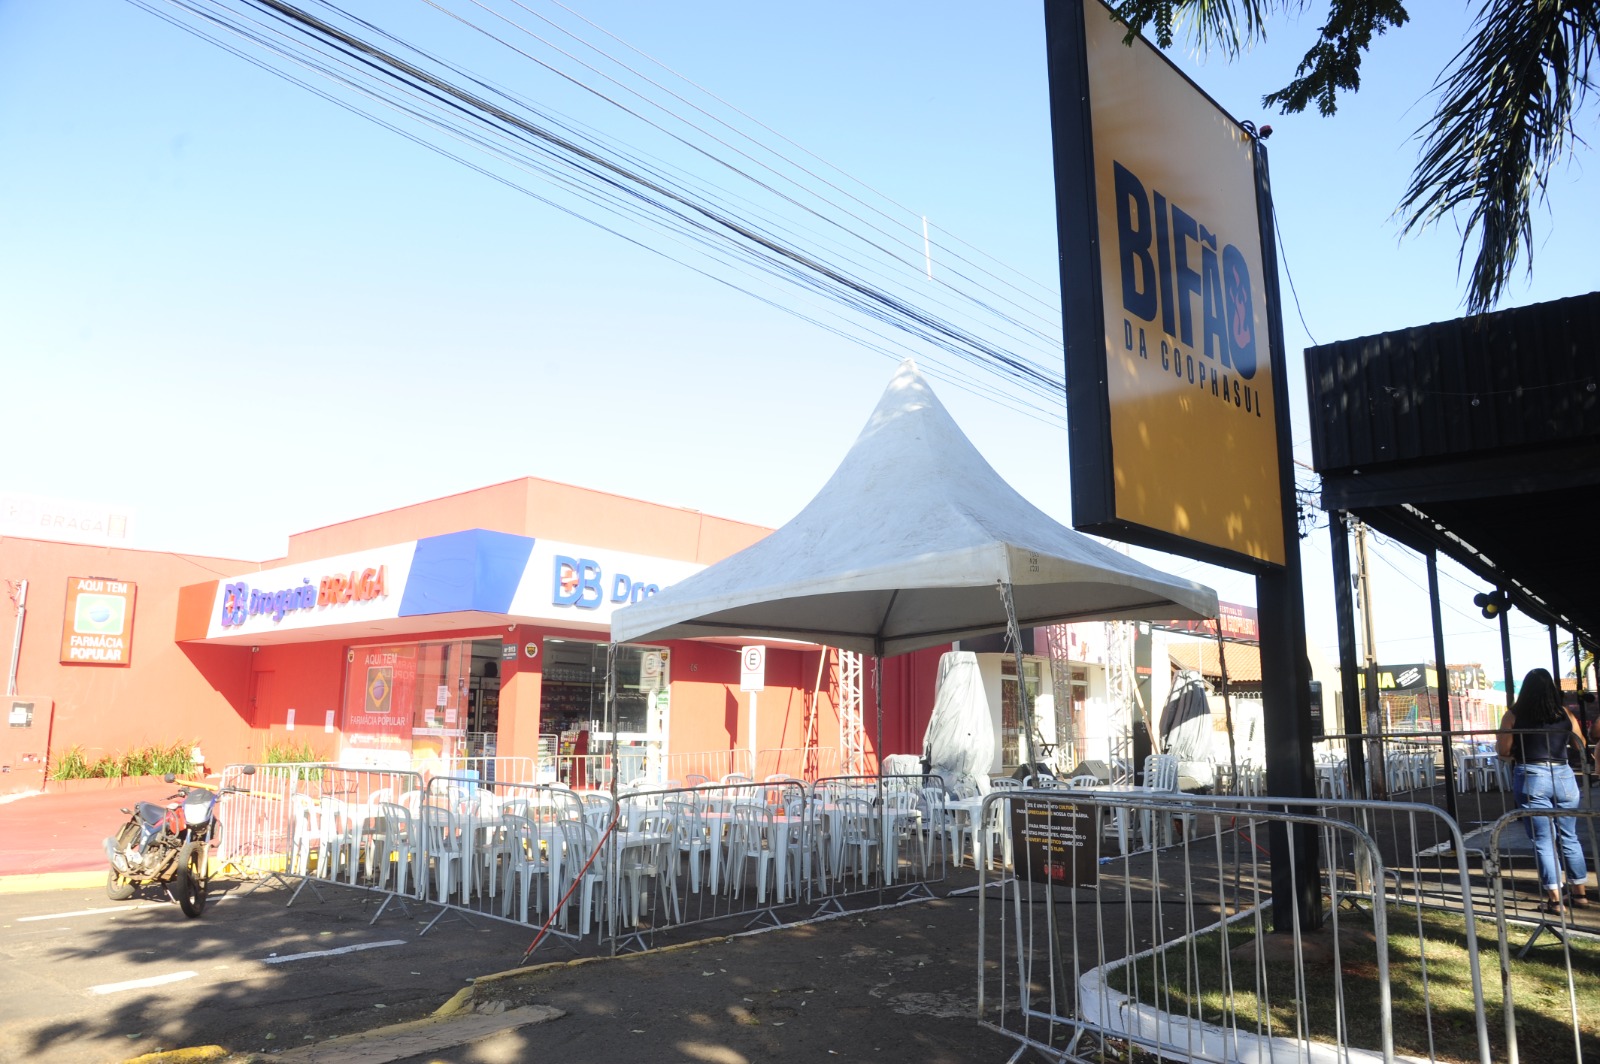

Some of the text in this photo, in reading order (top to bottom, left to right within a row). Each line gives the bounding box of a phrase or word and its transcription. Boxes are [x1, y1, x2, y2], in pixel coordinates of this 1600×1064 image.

[1113, 159, 1257, 380] BIFÃO
[1124, 318, 1261, 417] DA COOPHASUL
[77, 580, 128, 594] AQUI TEM
[317, 565, 389, 606] BRAGA
[70, 635, 123, 648] FARMÁCIA
[70, 648, 122, 661] POPULAR
[365, 653, 398, 665] AQUI TEM
[350, 714, 405, 726] FARMÁCIA POPULAR
